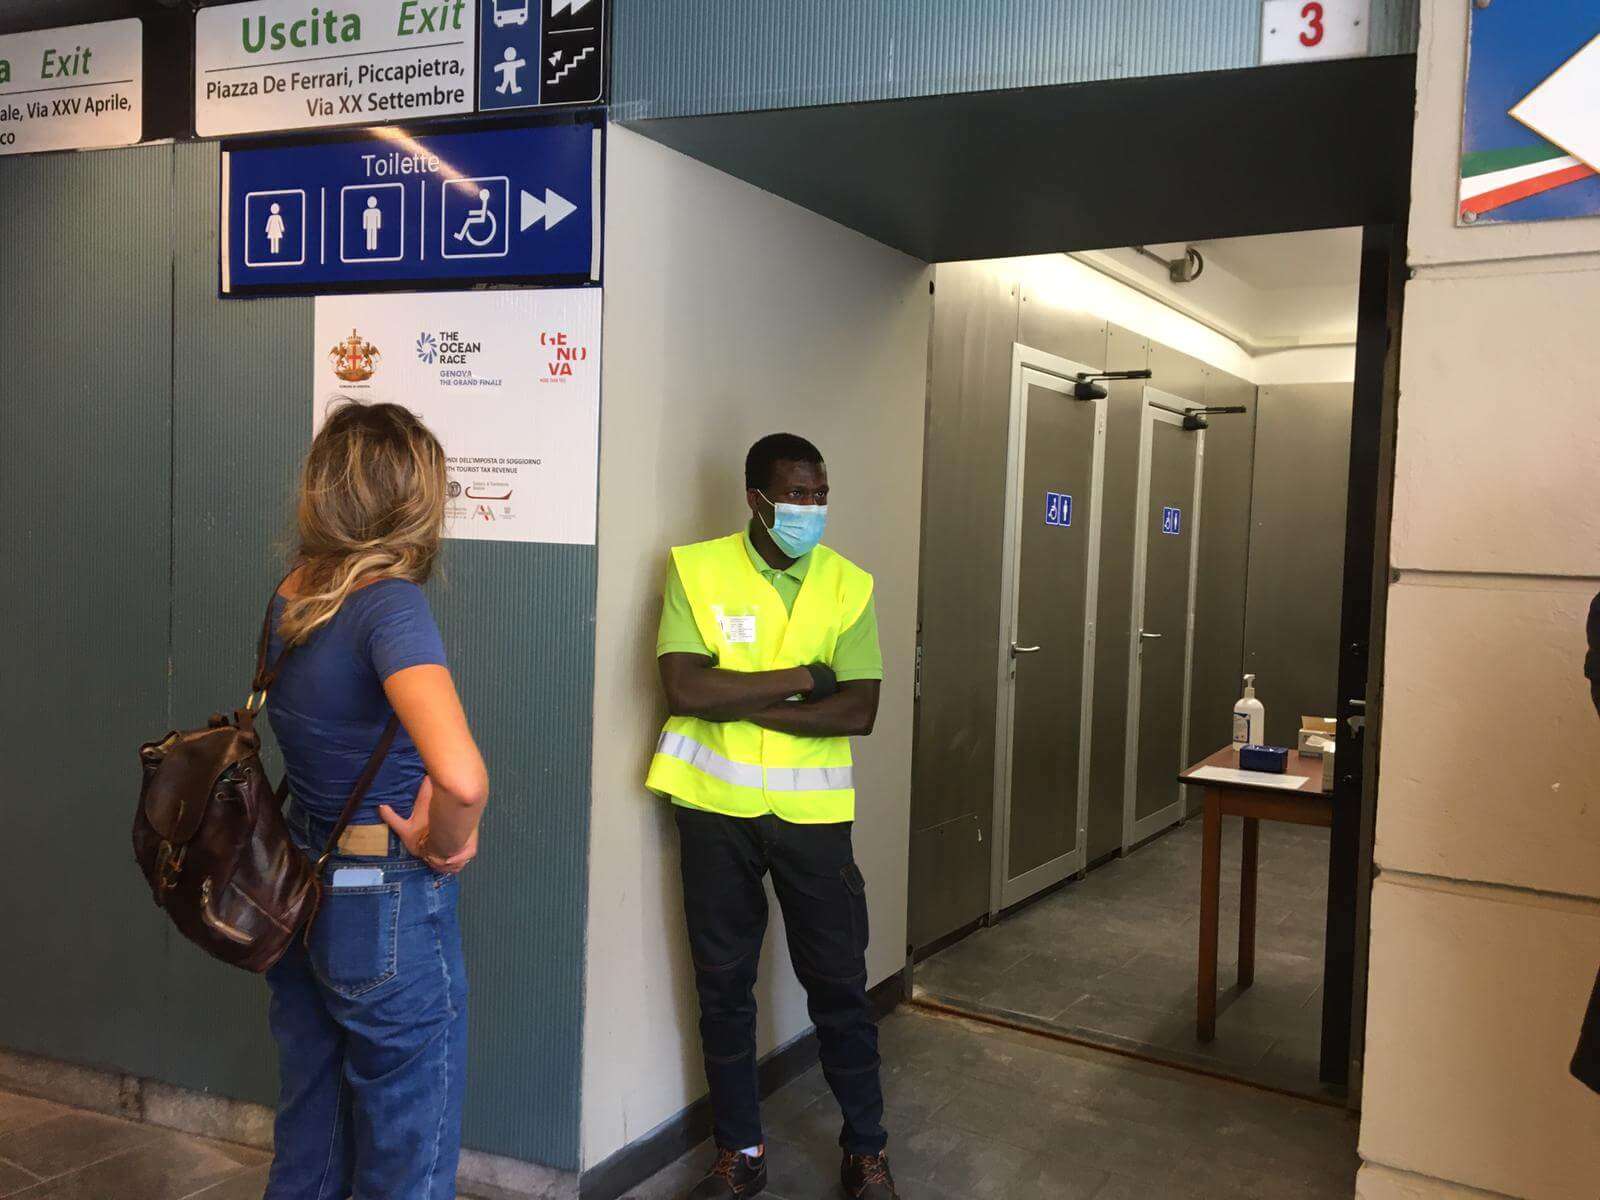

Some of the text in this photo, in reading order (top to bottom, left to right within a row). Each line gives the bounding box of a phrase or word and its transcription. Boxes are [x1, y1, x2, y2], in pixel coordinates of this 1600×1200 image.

[242, 0, 465, 53] Uscita Exit
[1299, 2, 1323, 47] 3
[41, 46, 92, 79] Exit
[206, 59, 465, 100] Piazza De Ferrari, Piccapietra,
[27, 102, 48, 118] Via
[52, 98, 81, 116] XXV
[84, 93, 132, 117] Aprile,
[307, 85, 465, 117] Via XX Settembre
[361, 152, 440, 176] Toilette
[439, 331, 459, 341] THE
[439, 342, 481, 353] OCEAN
[439, 355, 467, 364] RACE
[439, 370, 472, 378] GENOVA
